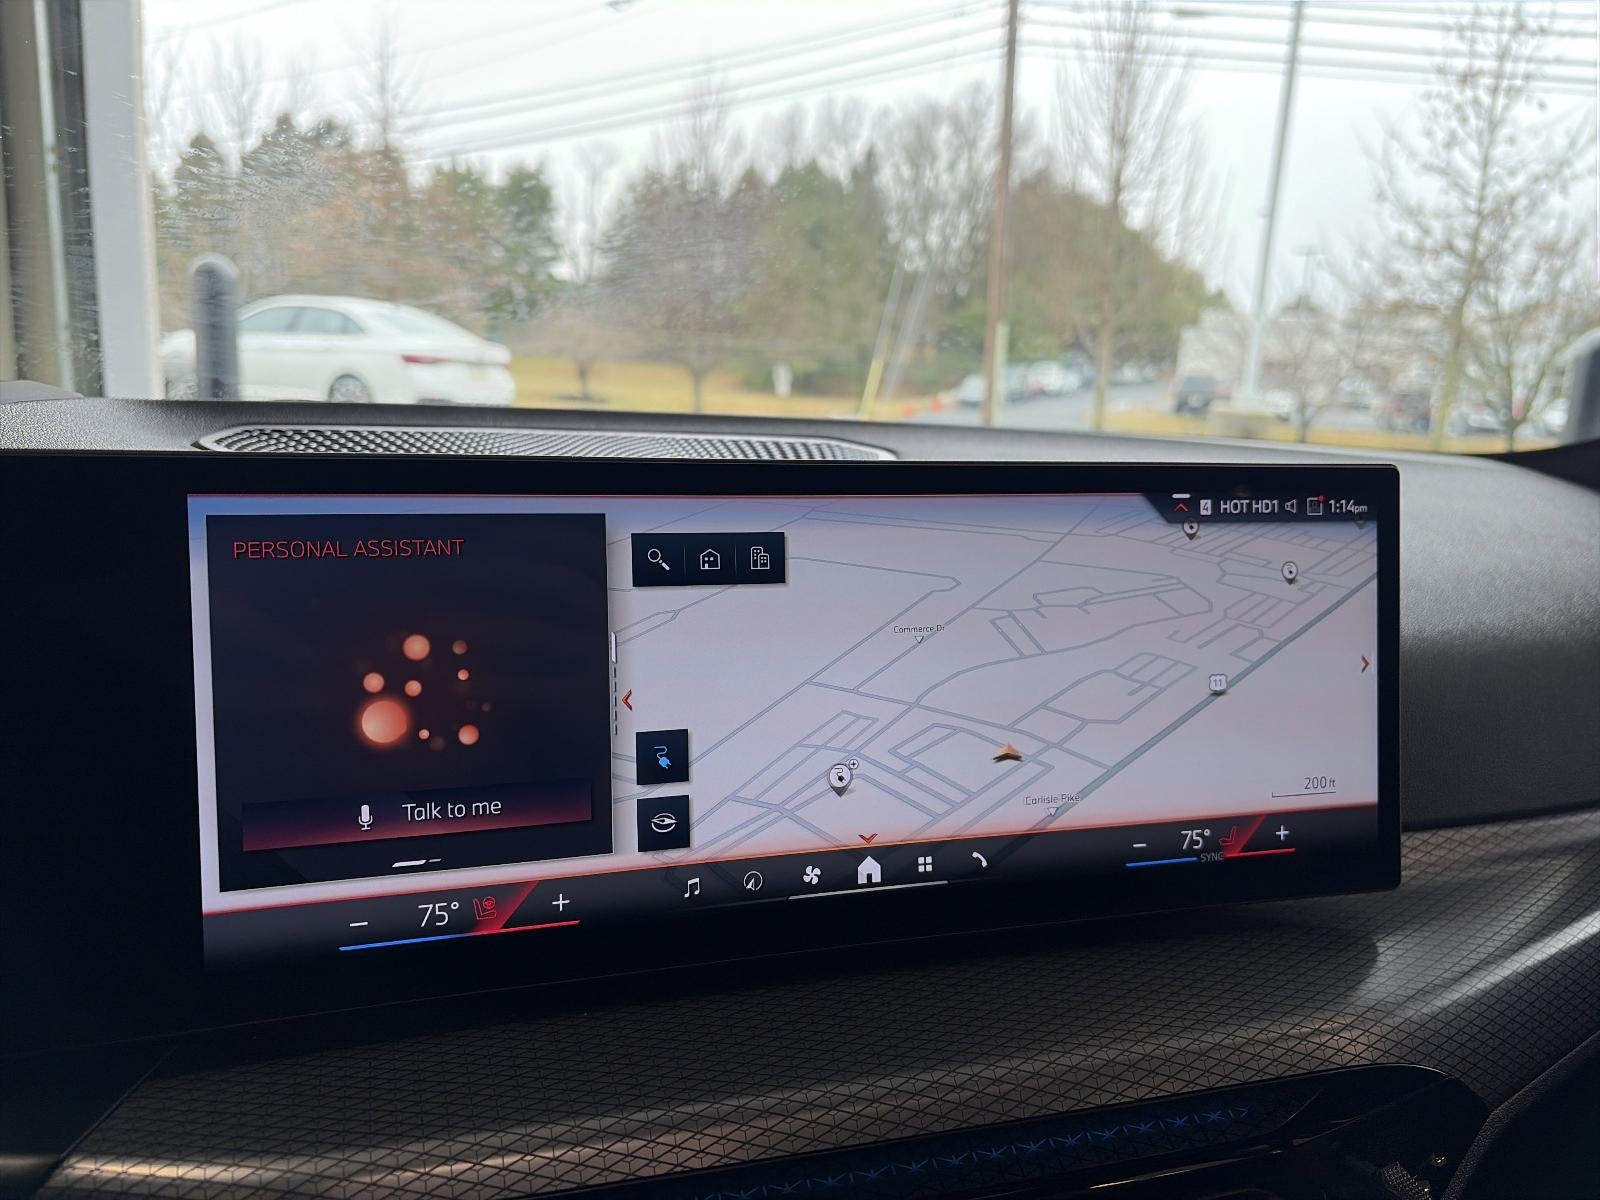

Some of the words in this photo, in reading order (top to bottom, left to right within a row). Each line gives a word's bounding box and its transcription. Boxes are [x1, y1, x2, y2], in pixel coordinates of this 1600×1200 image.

[1220, 499, 1250, 514] HOT
[1252, 499, 1278, 514] HD1
[233, 540, 349, 559] PERSONAL
[353, 539, 465, 557] ASSISTANT
[893, 625, 934, 634] Commerce
[1304, 776, 1327, 790] 200
[1025, 795, 1059, 806] Carlisle
[1061, 793, 1081, 802] Pike
[402, 801, 442, 821] Talk
[447, 802, 466, 818] to
[472, 800, 502, 816] me
[1200, 852, 1224, 862] SYNC
